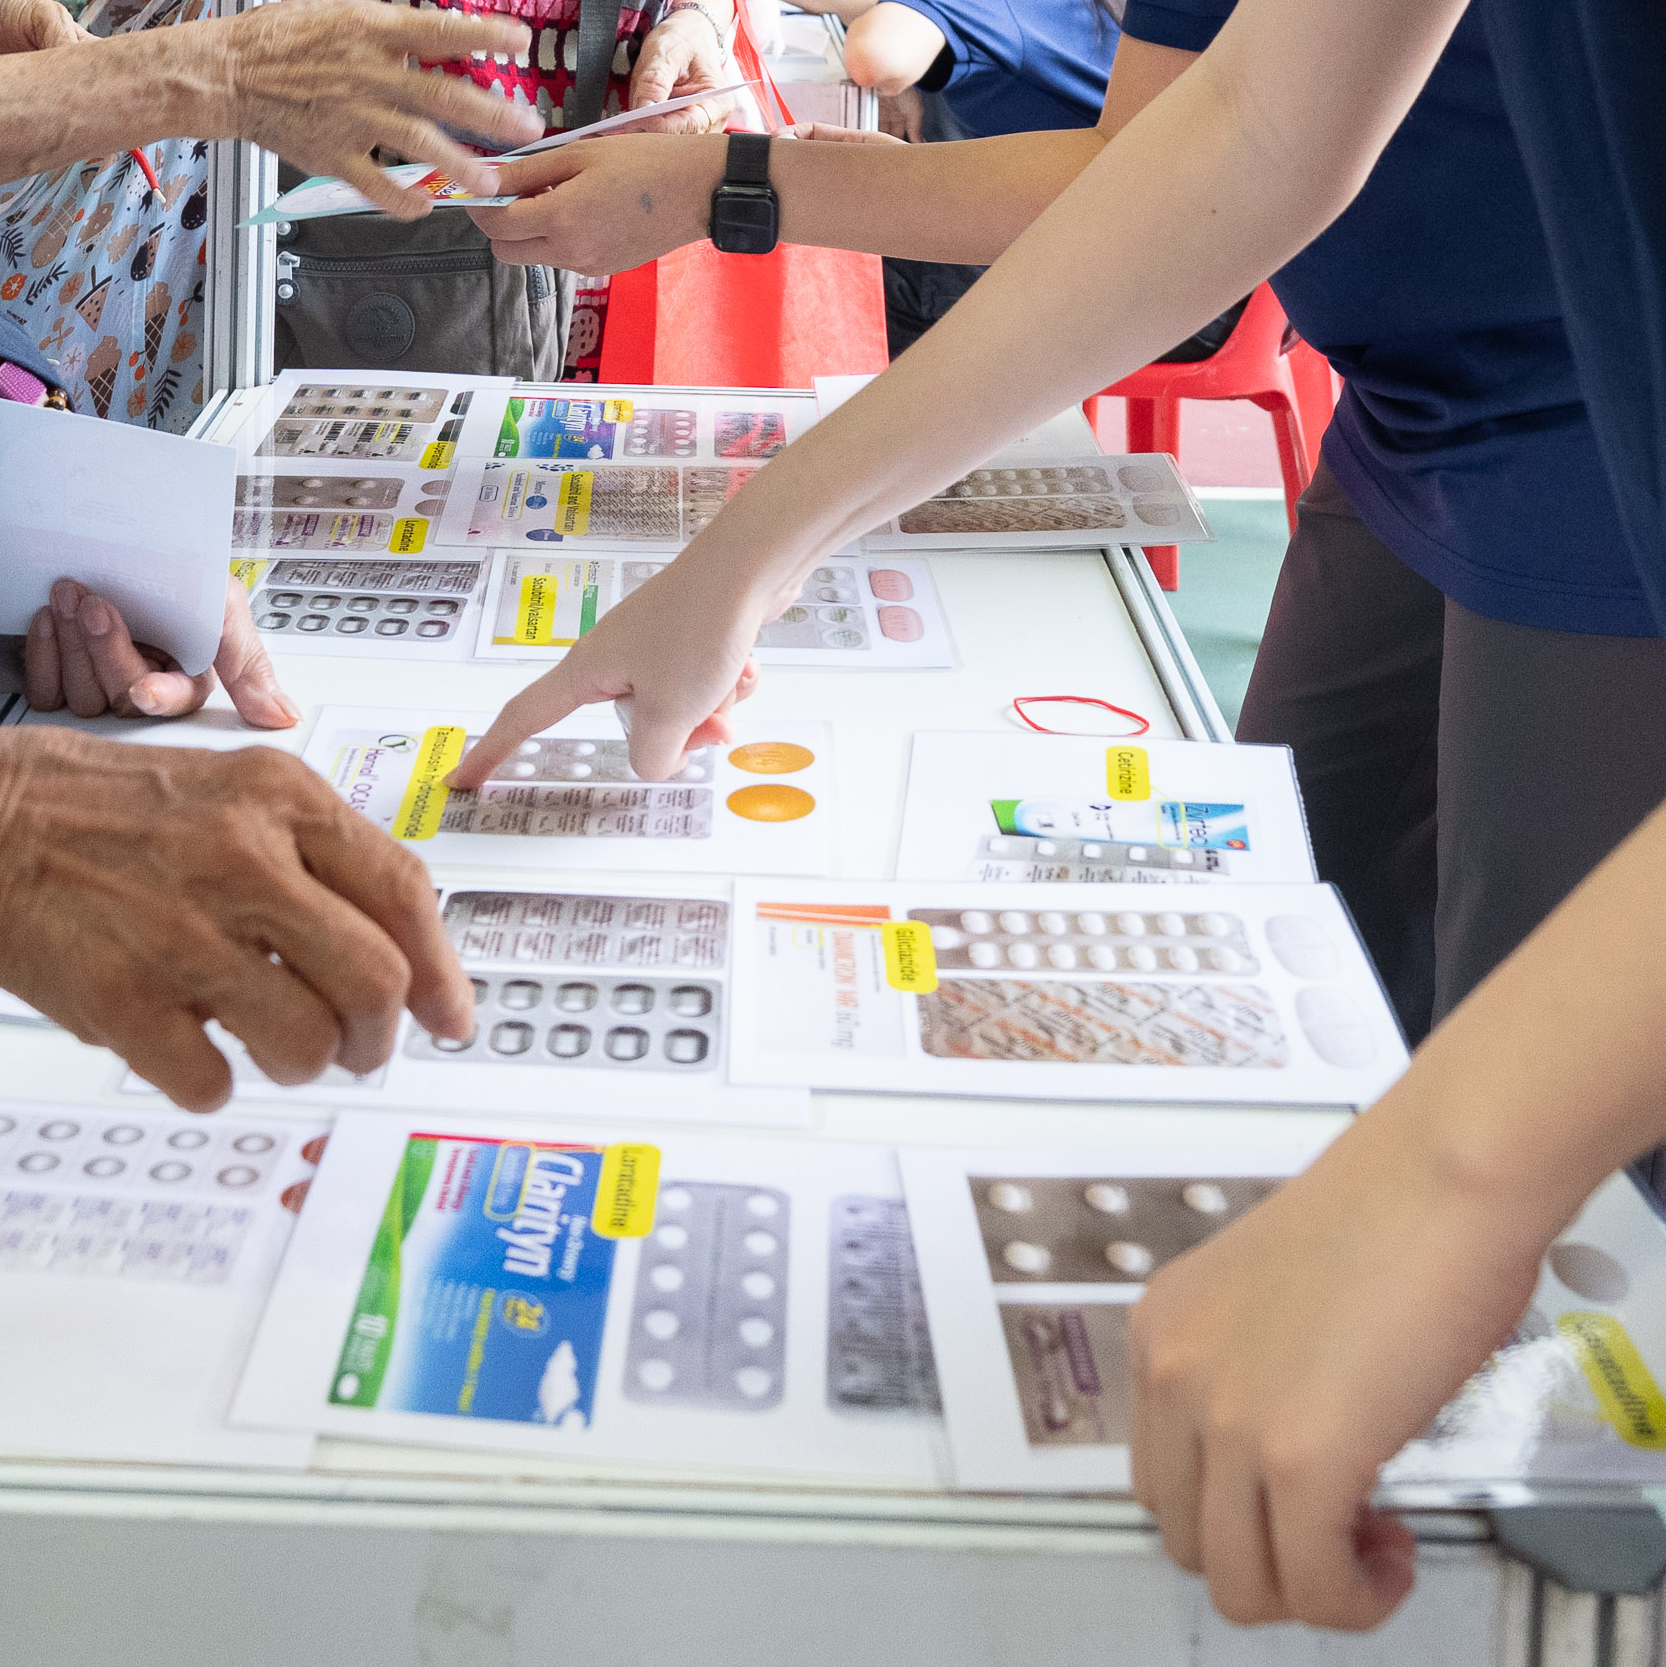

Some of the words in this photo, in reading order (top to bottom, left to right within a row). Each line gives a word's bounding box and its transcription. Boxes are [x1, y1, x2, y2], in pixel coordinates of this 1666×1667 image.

[566, 495, 578, 506] and
[568, 473, 584, 495] Sacubitril
[398, 519, 419, 552] Loratadine
[563, 505, 580, 532] Valsartan
[525, 577, 549, 640] Sacubitril/valsartan
[423, 726, 455, 775] Tamsulosin
[1117, 751, 1138, 795] Cetirizine
[494, 1150, 586, 1278] Clarityn
